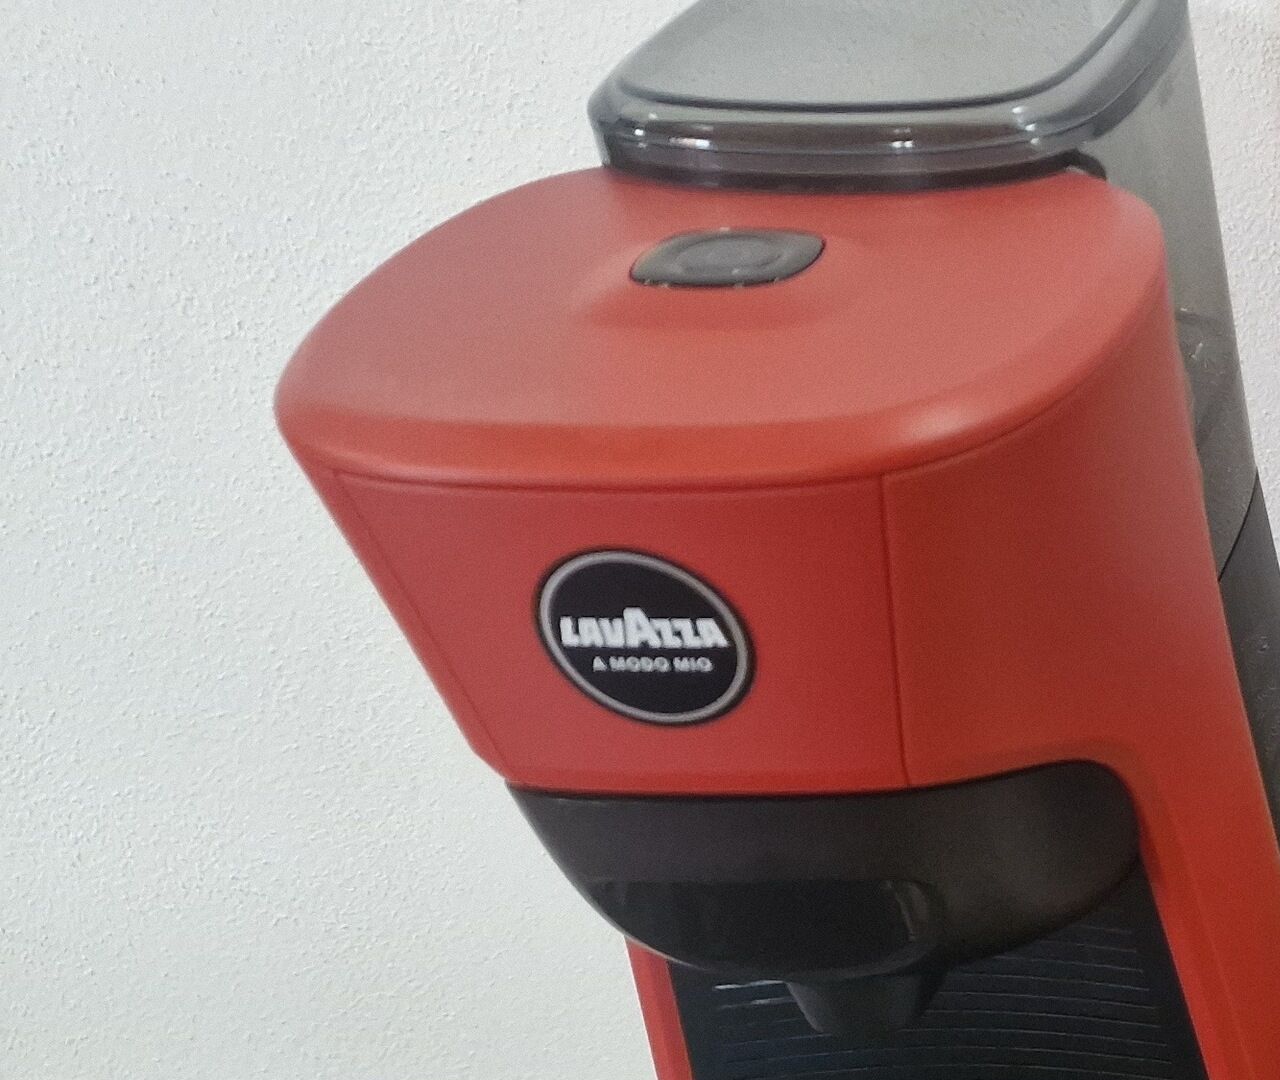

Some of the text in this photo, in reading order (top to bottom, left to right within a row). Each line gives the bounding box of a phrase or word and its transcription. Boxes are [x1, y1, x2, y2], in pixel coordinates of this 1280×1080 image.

[559, 607, 729, 648] LAVAZZA
[593, 656, 713, 672] A MODO MIO
